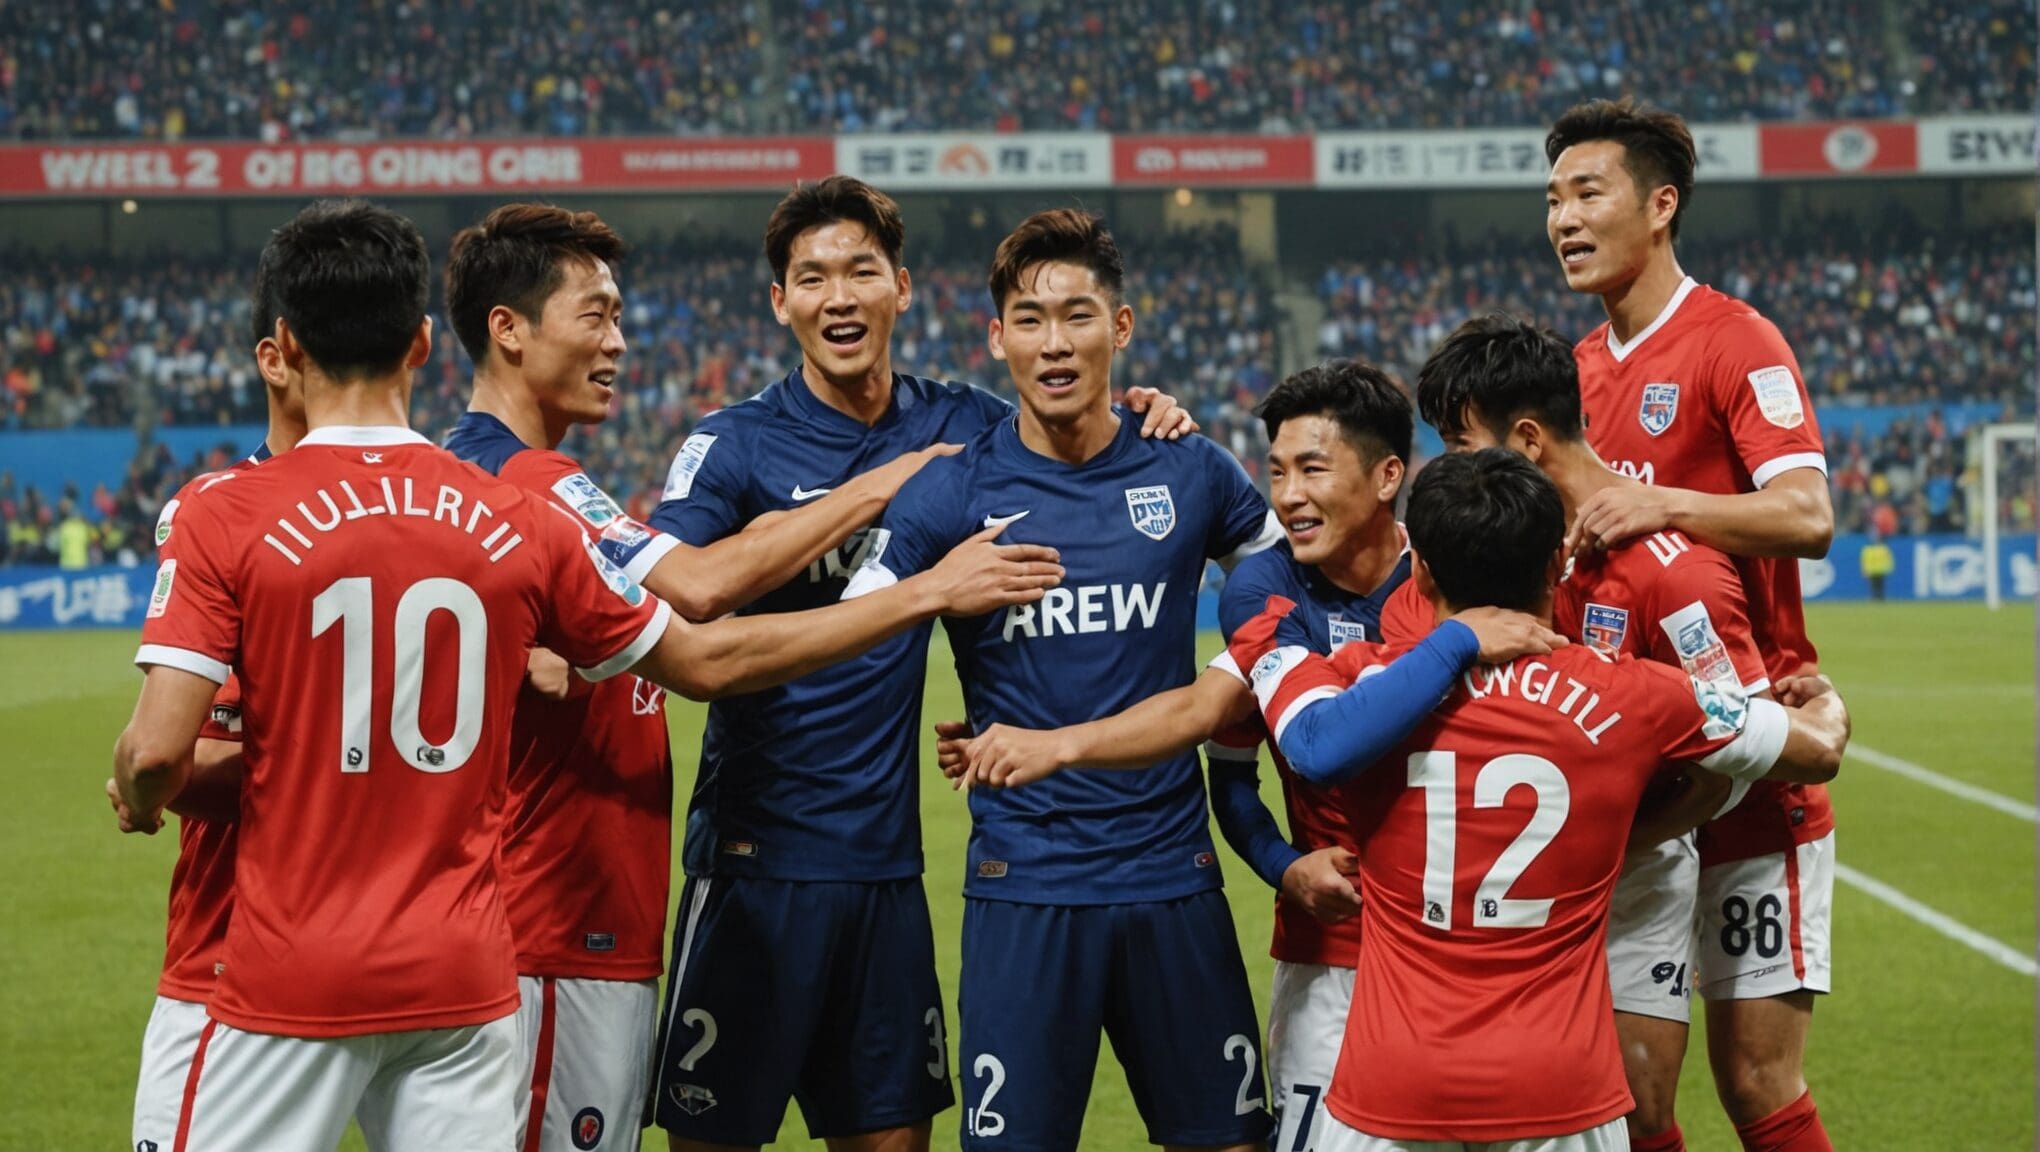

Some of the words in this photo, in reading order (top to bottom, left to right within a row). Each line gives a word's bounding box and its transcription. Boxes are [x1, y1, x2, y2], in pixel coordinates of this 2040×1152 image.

[311, 576, 488, 774] 10
[1406, 749, 1571, 931] 12
[1719, 893, 1783, 960] 86
[1222, 1033, 1264, 1116] 2
[1291, 1083, 1322, 1152] 7
